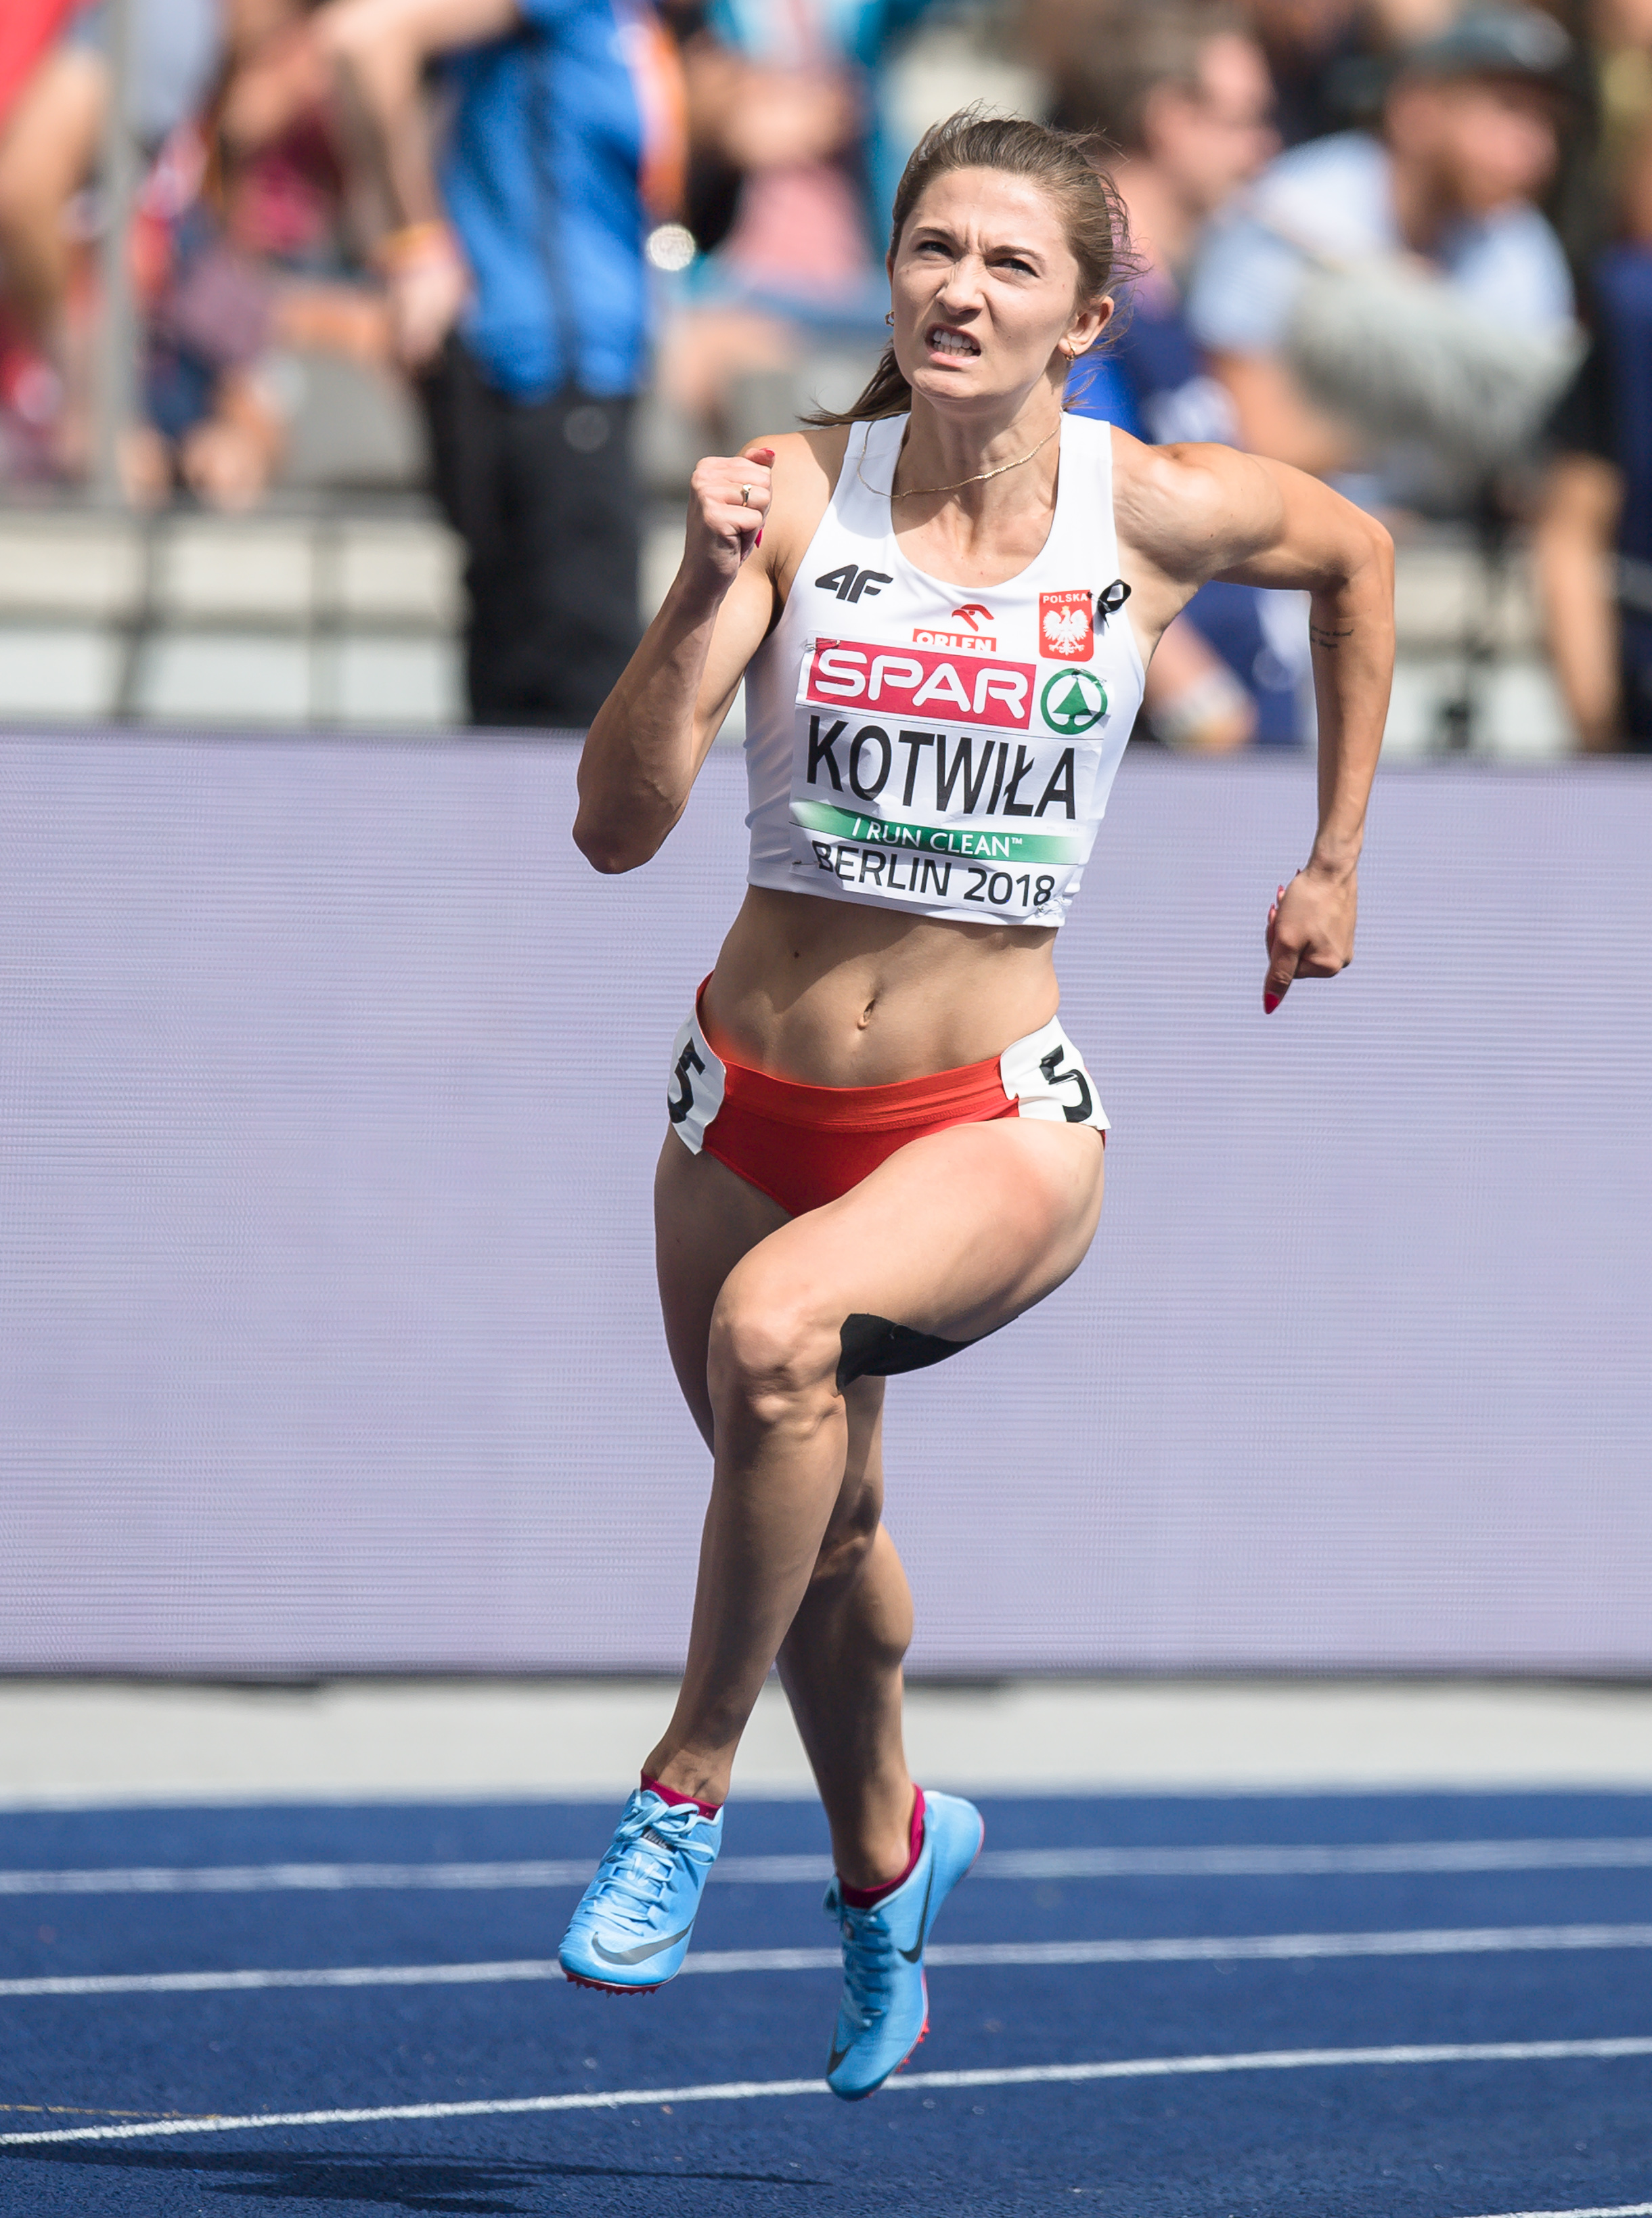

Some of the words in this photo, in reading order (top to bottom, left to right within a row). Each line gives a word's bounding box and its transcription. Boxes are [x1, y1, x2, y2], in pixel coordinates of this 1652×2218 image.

[815, 564, 893, 604] 4F
[1043, 593, 1088, 604] POLSKA
[918, 632, 992, 651] ORLEN
[815, 650, 1029, 719] SPAR
[806, 715, 1076, 820] KOTWIŁA
[852, 818, 861, 837] I
[866, 821, 922, 848] RUN
[812, 840, 952, 897] BERLIN
[963, 867, 1055, 907] 2018
[667, 1038, 706, 1124] 5
[1040, 1044, 1092, 1123] 5
